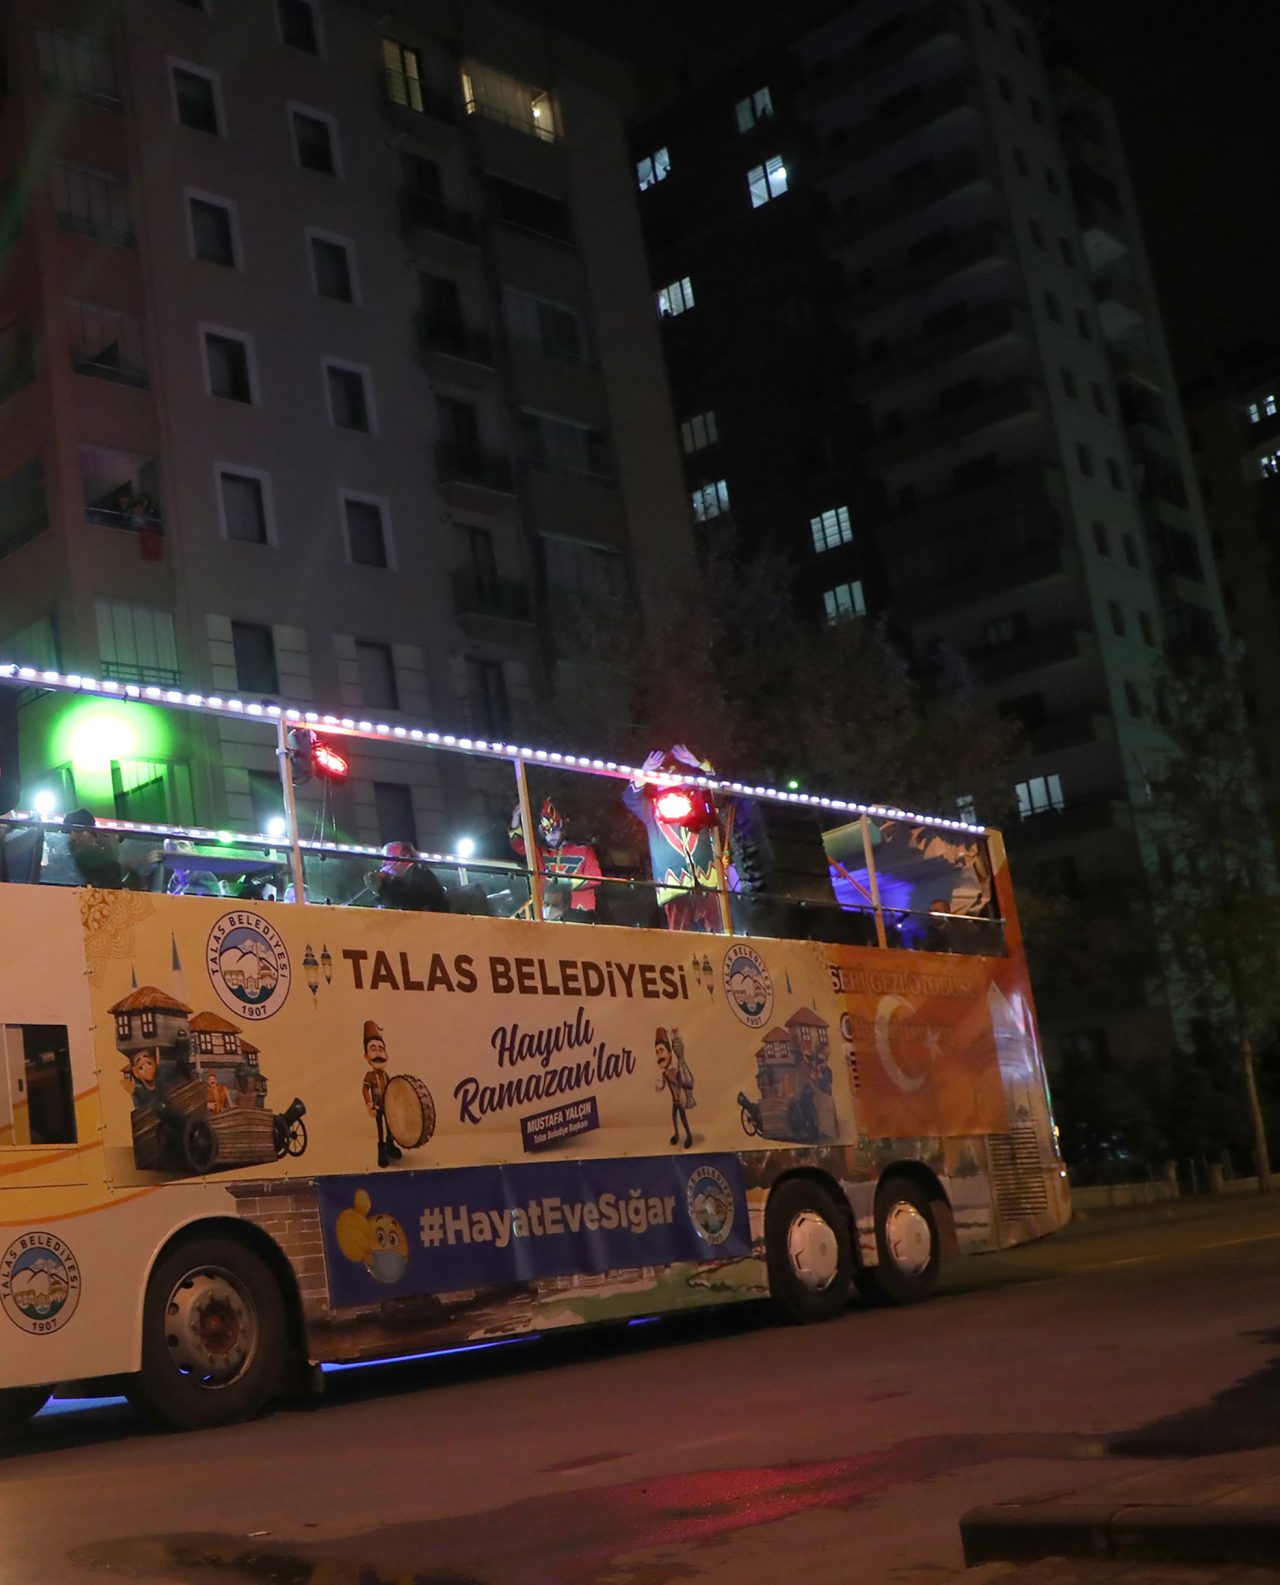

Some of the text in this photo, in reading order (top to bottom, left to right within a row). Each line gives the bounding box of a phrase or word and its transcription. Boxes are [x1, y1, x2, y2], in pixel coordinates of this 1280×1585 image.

[209, 914, 288, 979] TALAS BELEDİYESİ
[342, 949, 689, 1000] TALAS BELEDİYESİ
[241, 1005, 267, 1017] 1907
[491, 1006, 594, 1068] Hayırlı
[453, 1042, 636, 1125] Ramazan'lar
[527, 1101, 592, 1134] MUSTAFA YALÇIN
[420, 1187, 676, 1248] #HayatEveSığar
[1, 1235, 78, 1300] TALAS BELEDİYESİ
[31, 1318, 58, 1331] 1907
